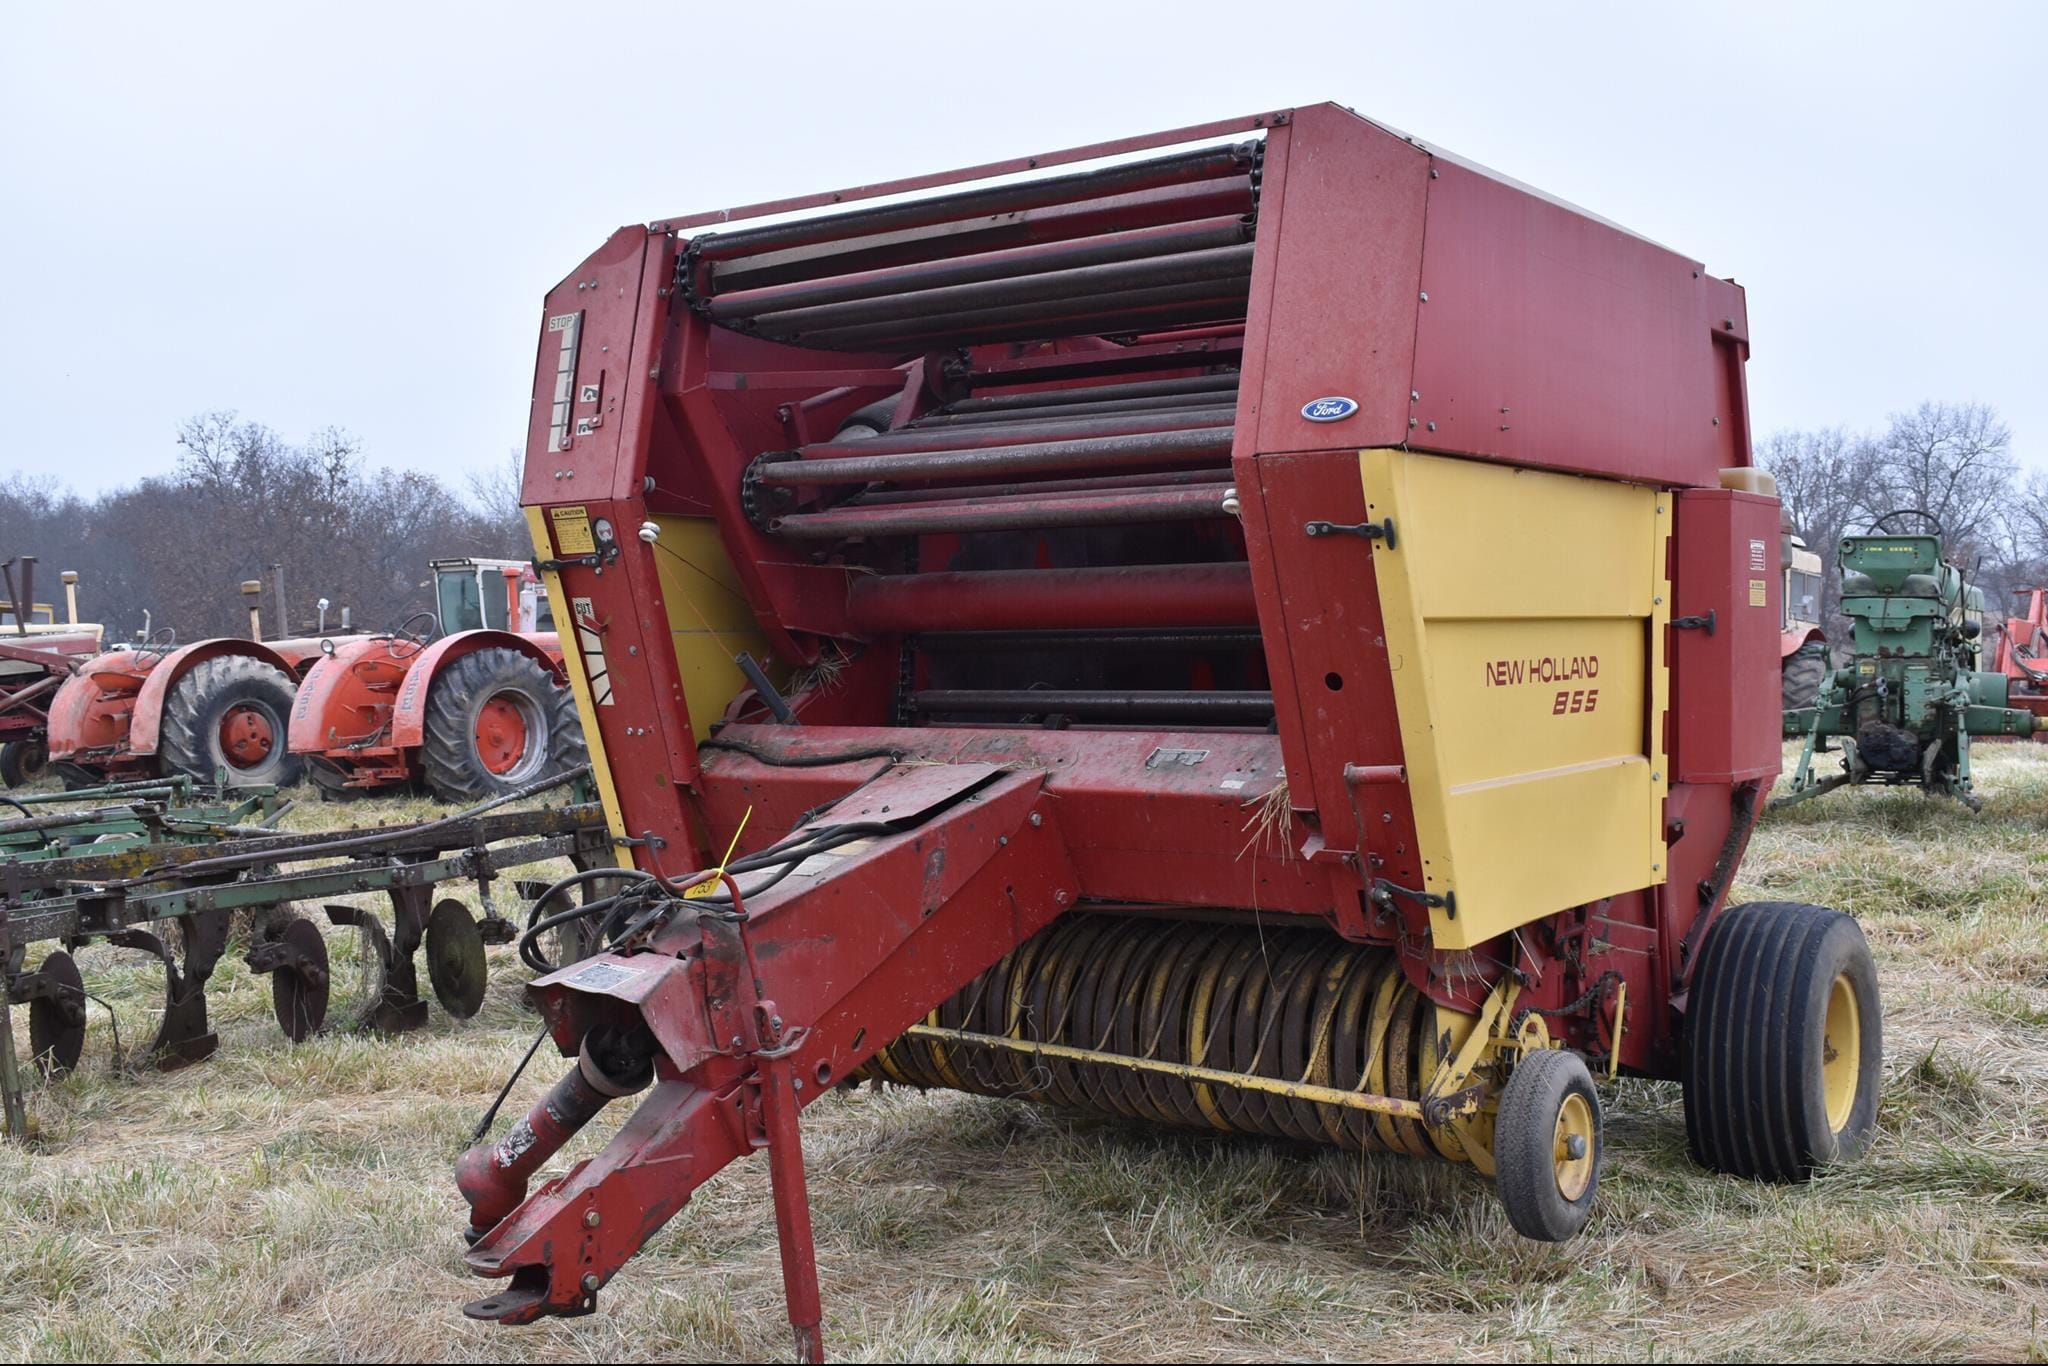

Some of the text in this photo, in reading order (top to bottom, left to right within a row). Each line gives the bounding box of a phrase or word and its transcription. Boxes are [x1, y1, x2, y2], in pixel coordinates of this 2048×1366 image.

[550, 315, 573, 330] STOP
[1313, 401, 1344, 417] Ford
[559, 509, 585, 517] CAUTION
[575, 602, 592, 614] CUT
[1486, 655, 1599, 687] NEW HOLLAND
[1552, 689, 1599, 716] 855
